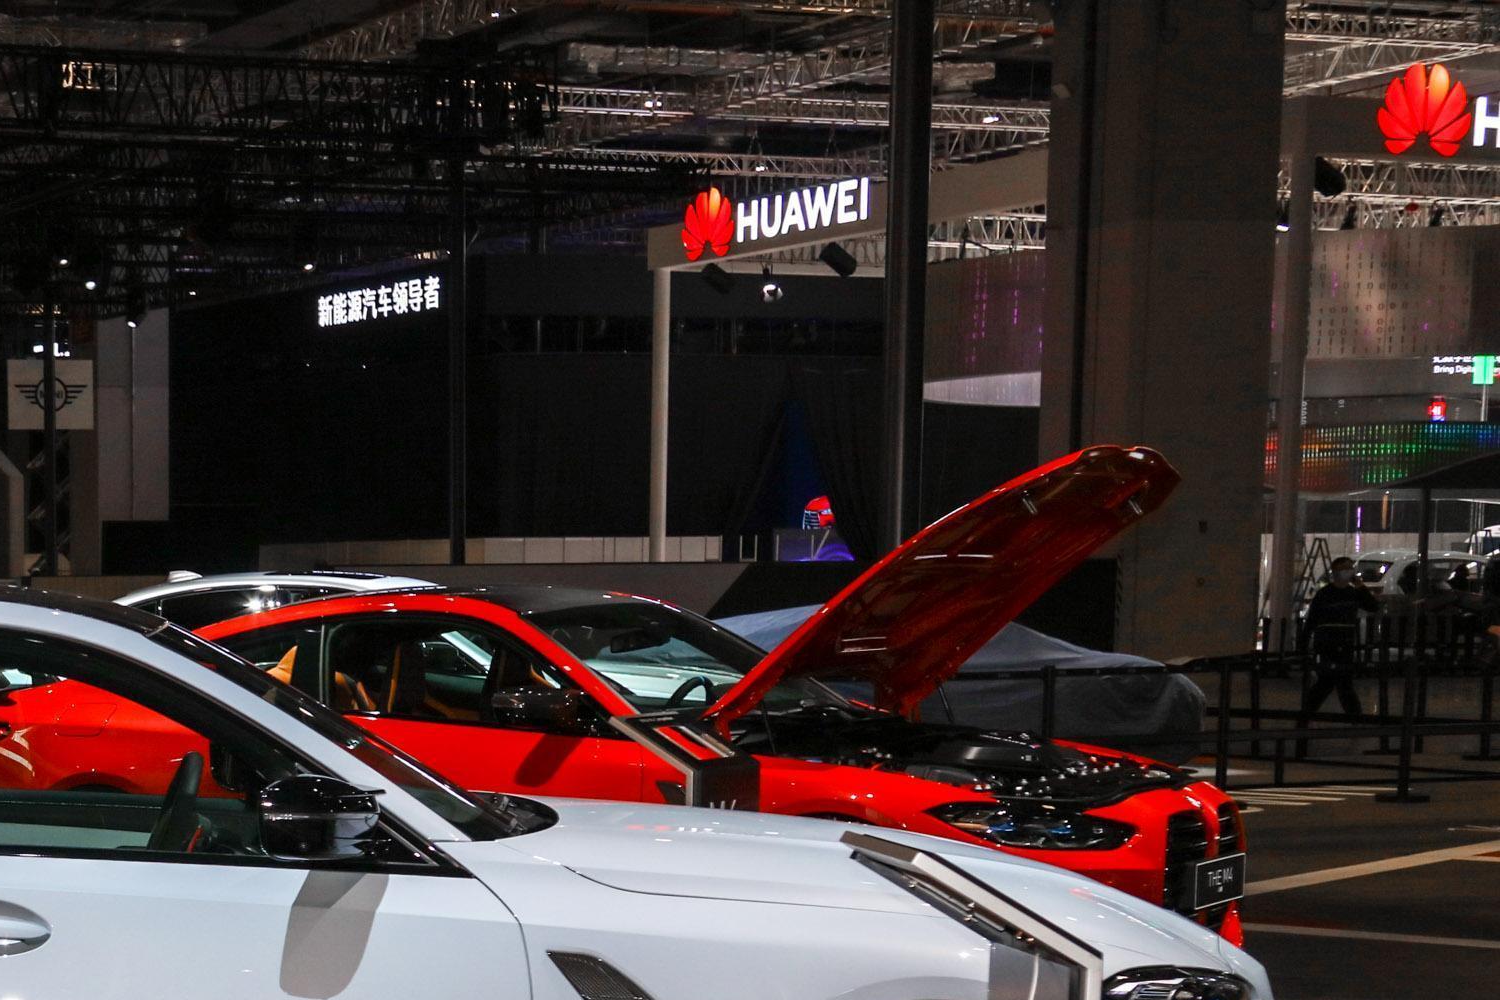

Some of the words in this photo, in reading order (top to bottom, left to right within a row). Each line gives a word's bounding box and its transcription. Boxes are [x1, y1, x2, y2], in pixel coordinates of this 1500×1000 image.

[736, 176, 869, 243] HUAWEI
[317, 276, 441, 328] 新能源汽车领导者
[1207, 869, 1222, 888] THE
